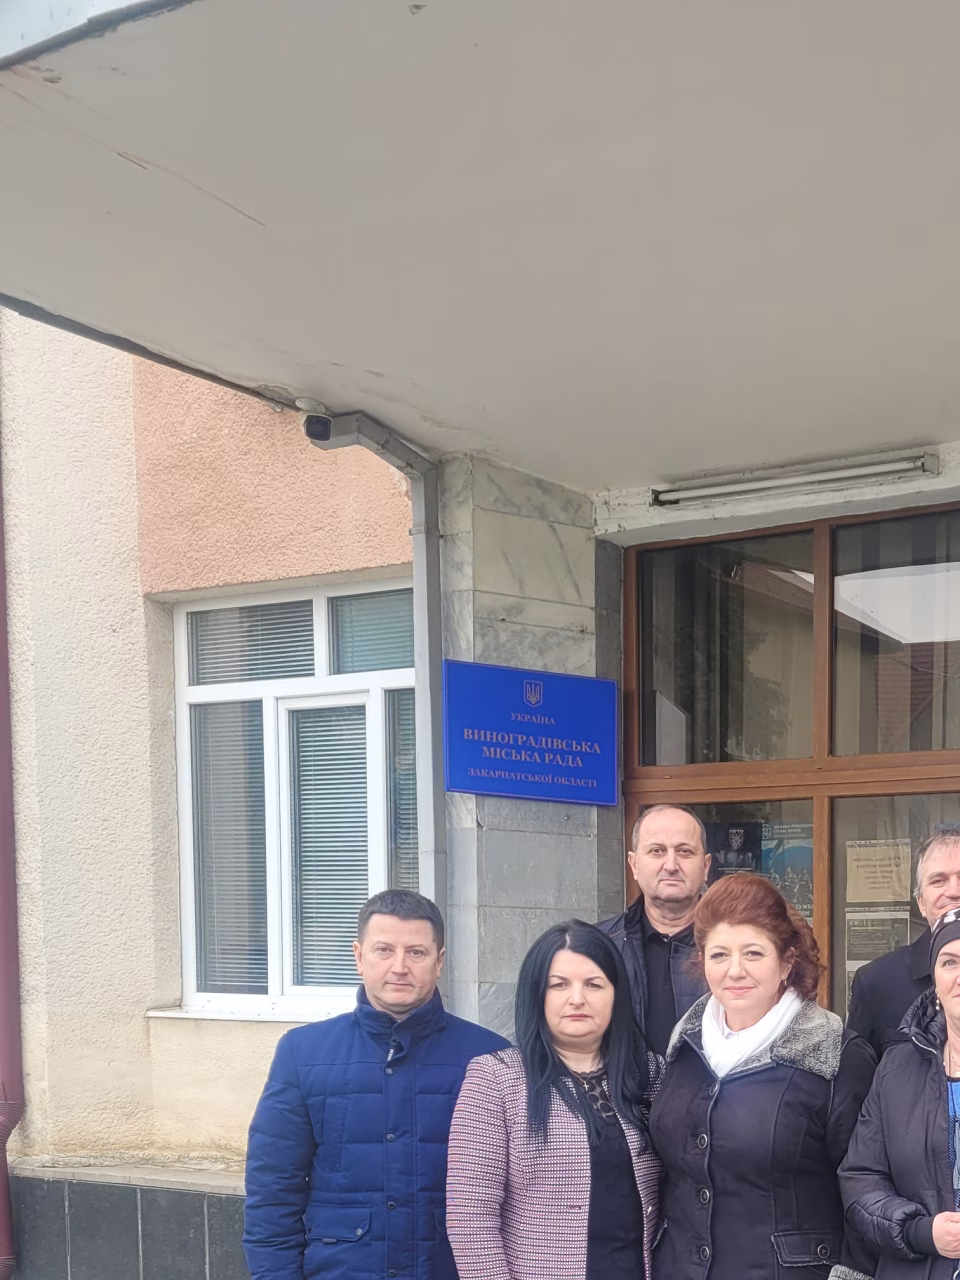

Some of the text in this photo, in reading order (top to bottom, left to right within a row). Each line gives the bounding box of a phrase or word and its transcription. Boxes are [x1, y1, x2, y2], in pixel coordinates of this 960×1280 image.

[510, 712, 555, 725] УКРАЇНА
[463, 728, 601, 754] ВИНОГРАДІВСЬКА
[482, 746, 583, 767] МІСЬКА РАДА
[467, 768, 598, 788] ЗАКАРПАТСЬКОЇ ОБЛАСТІ
